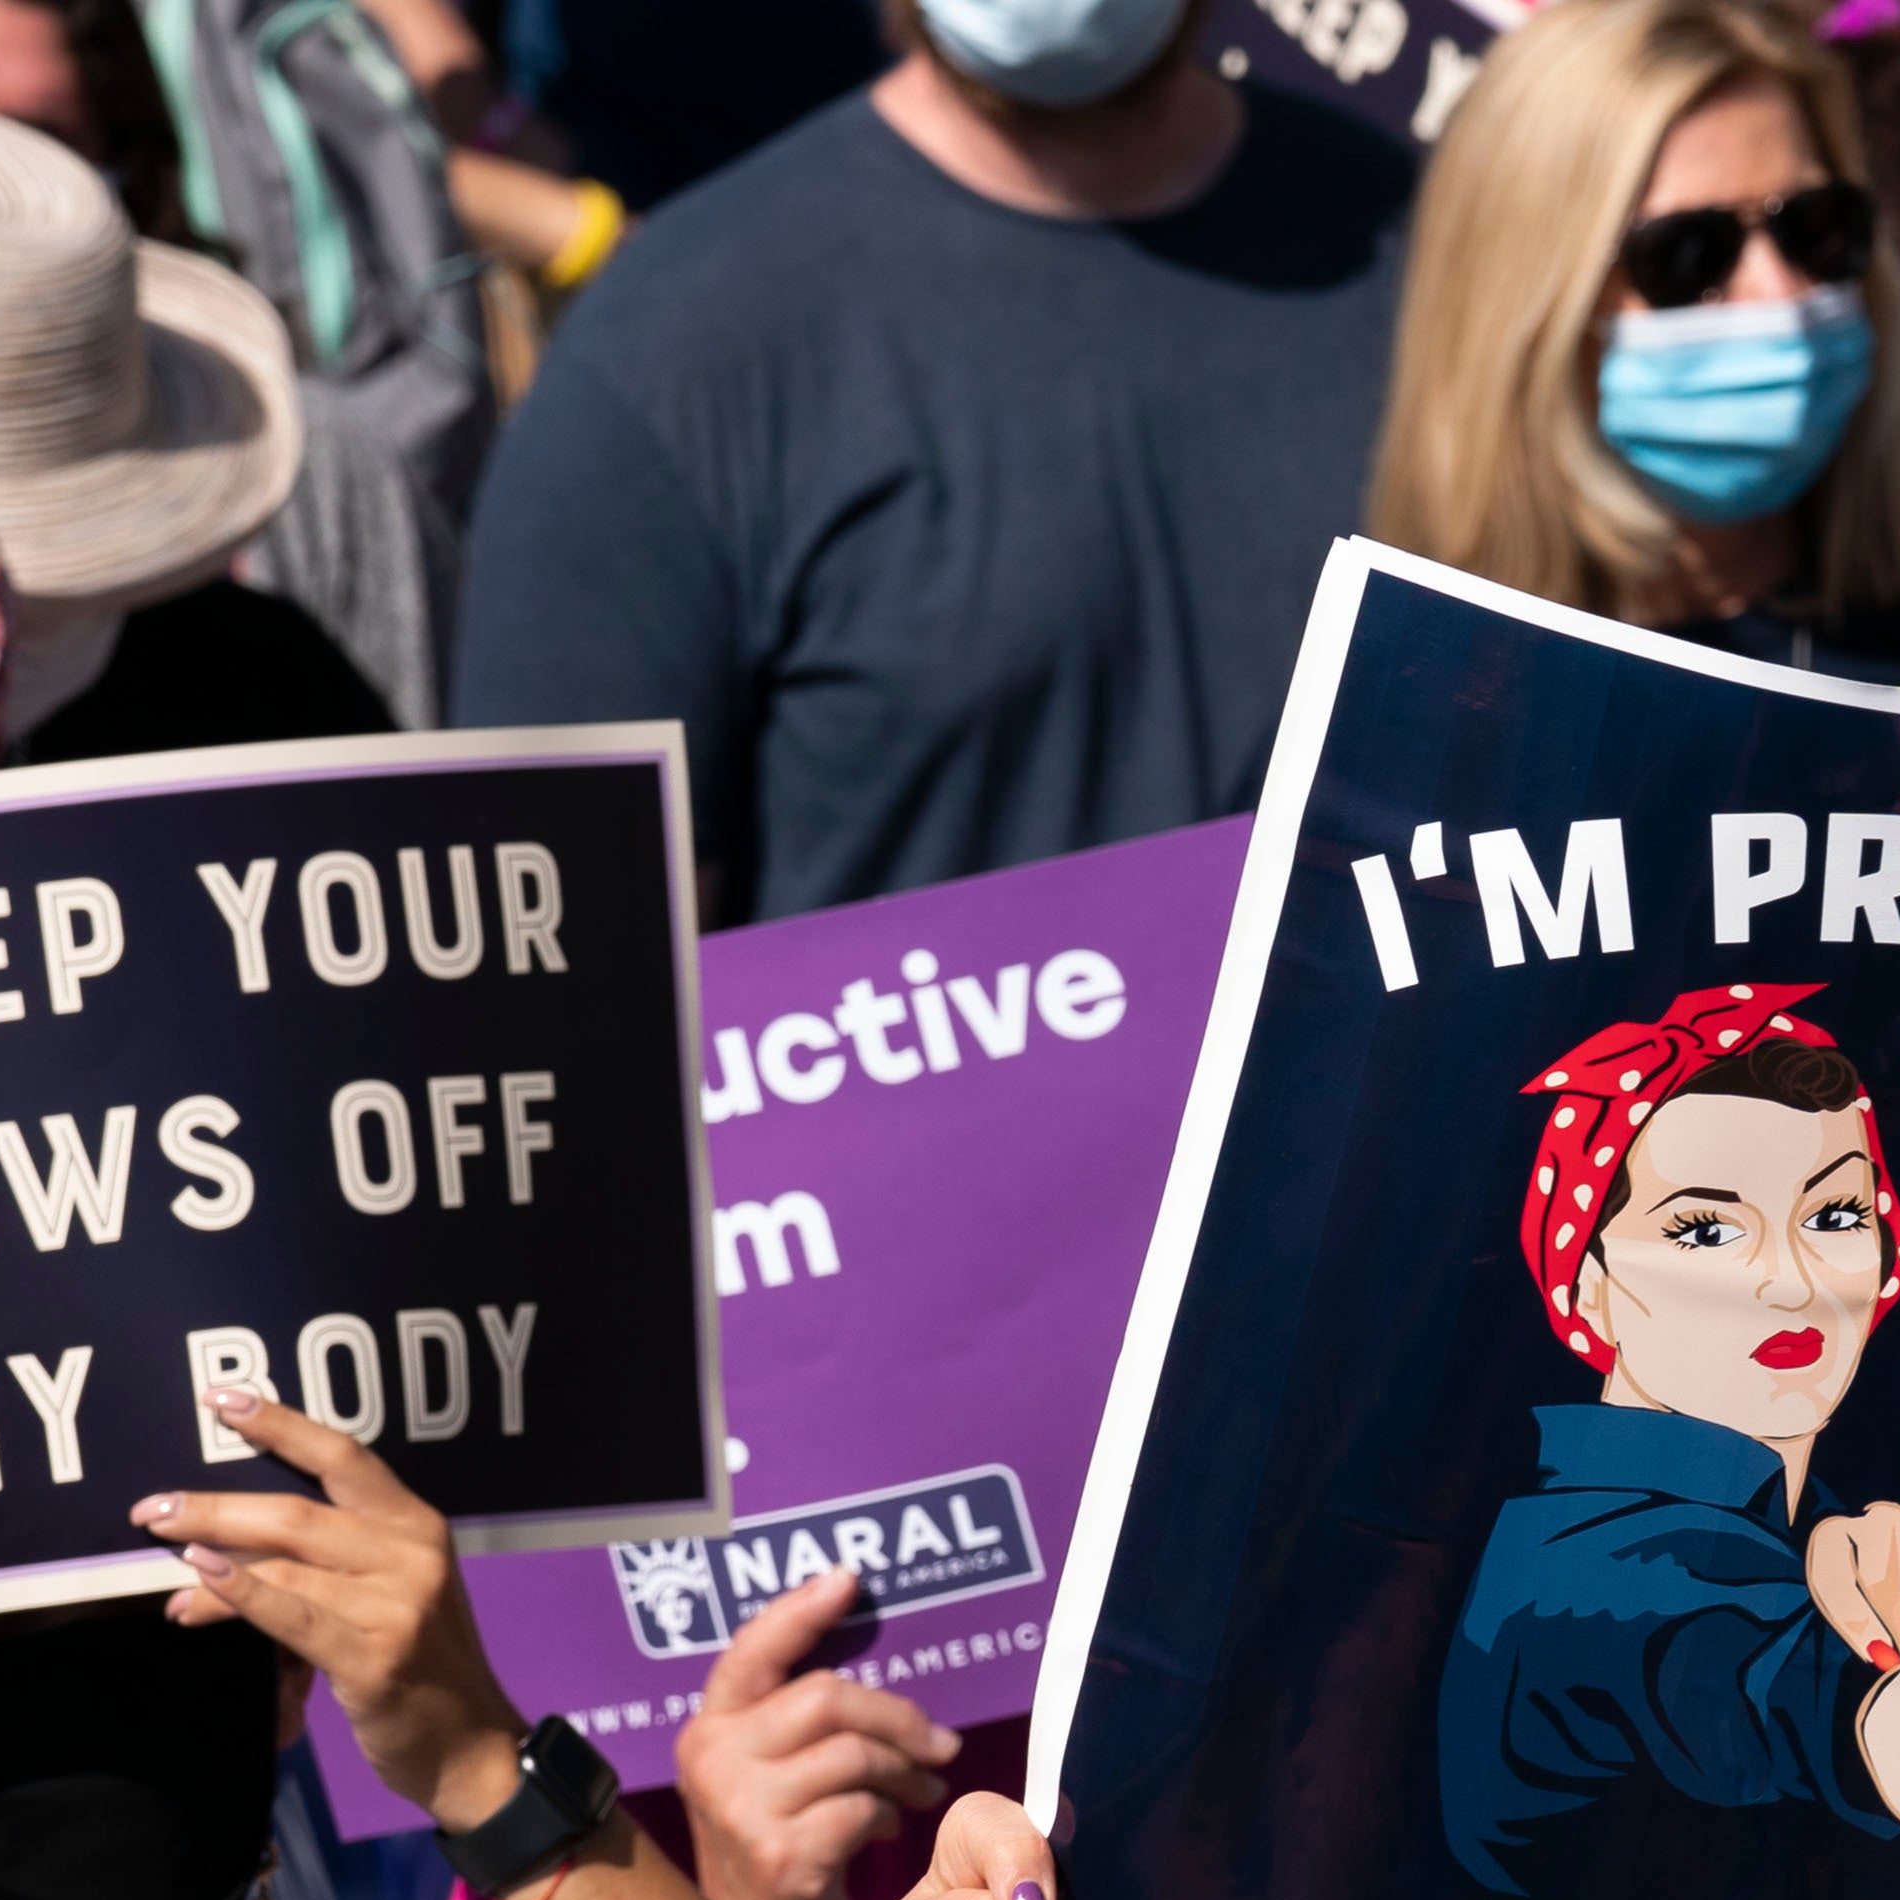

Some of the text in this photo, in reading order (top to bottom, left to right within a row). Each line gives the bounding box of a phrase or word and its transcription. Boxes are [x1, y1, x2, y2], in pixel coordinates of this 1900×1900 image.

[195, 842, 569, 995] YOUR
[329, 1071, 557, 1216] OFF
[185, 1303, 538, 1464] BODY
[723, 1494, 1002, 1599] NARAL
[896, 1548, 1009, 1589] AMERICA
